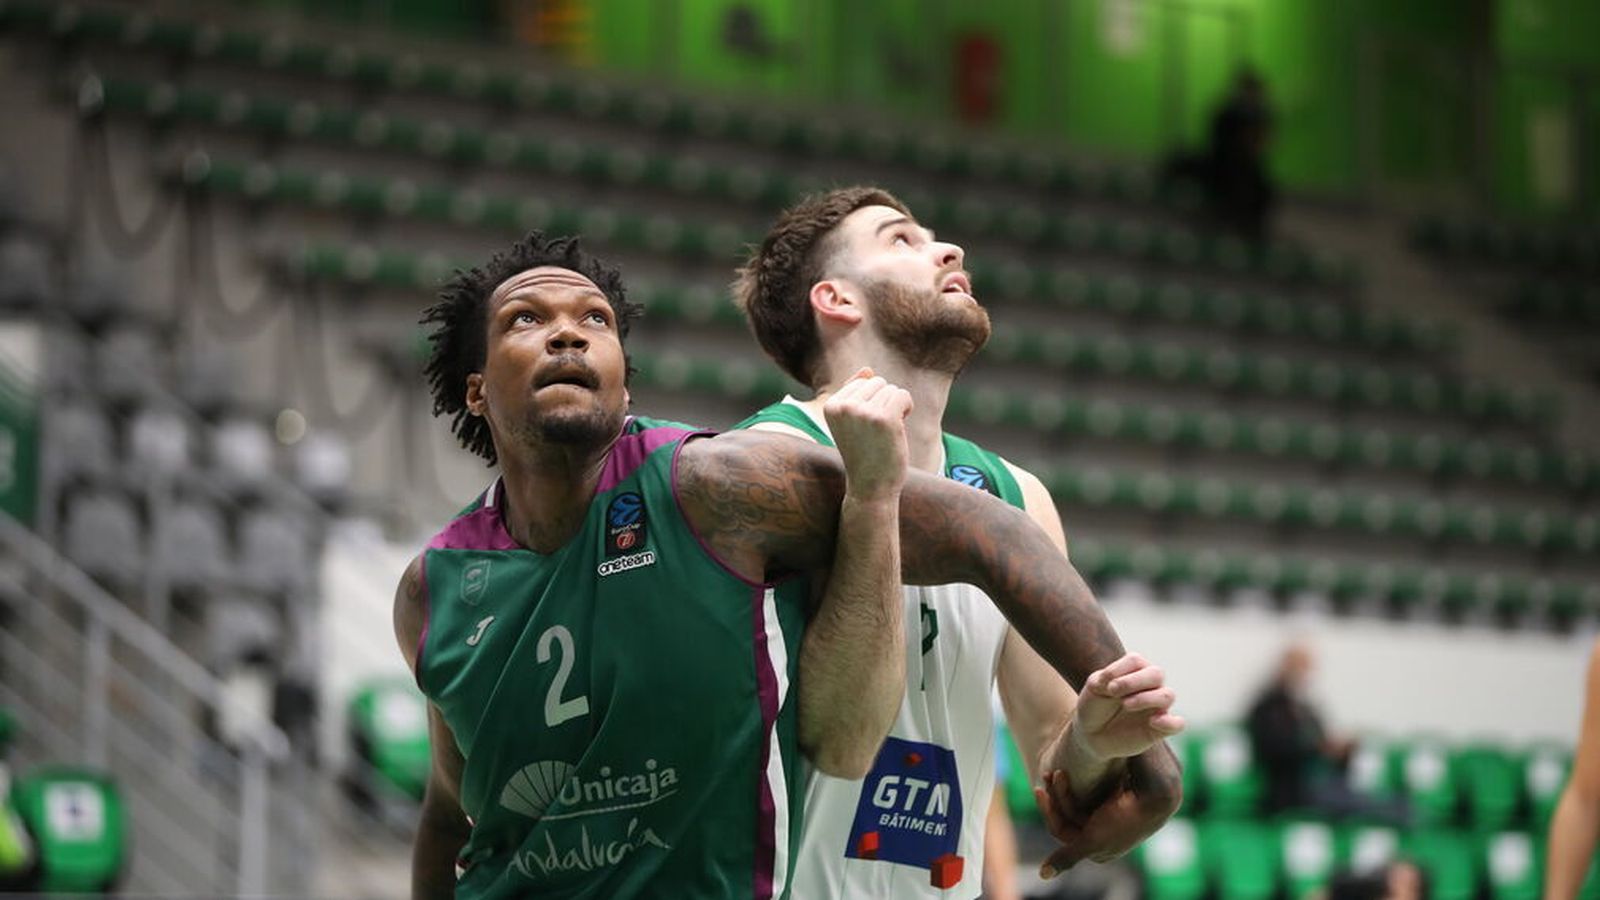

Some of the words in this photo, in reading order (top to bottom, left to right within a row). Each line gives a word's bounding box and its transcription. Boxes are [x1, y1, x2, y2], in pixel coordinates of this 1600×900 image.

[598, 551, 656, 576] oneteam
[536, 624, 590, 728] 2
[559, 758, 678, 806] Unicaja
